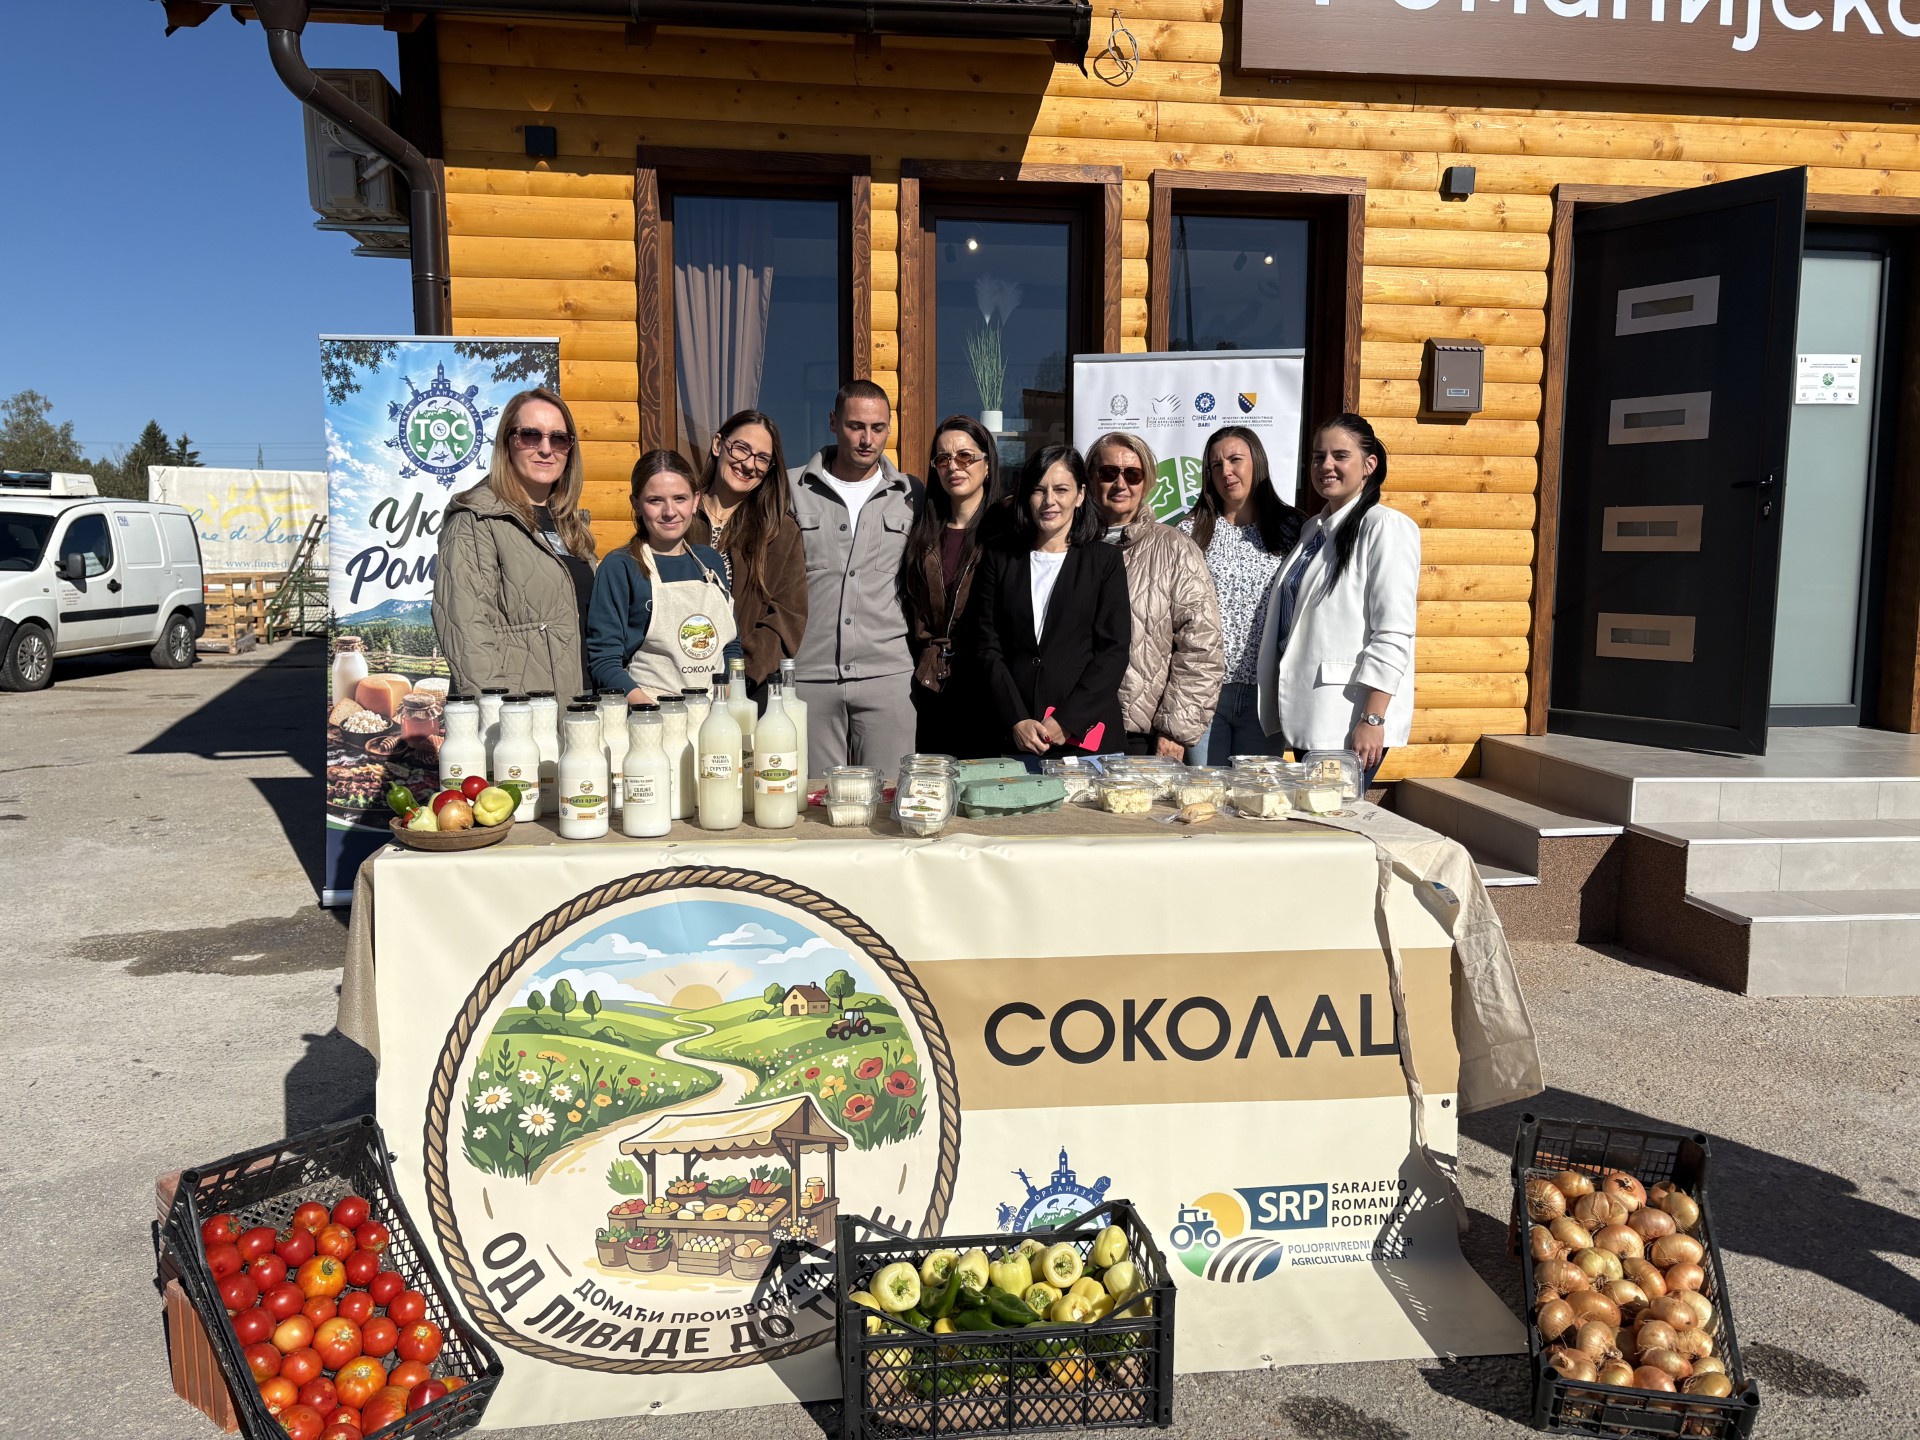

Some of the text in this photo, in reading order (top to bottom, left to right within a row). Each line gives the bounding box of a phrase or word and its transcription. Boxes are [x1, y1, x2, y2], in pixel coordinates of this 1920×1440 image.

[368, 491, 442, 549] Ук
[345, 545, 439, 605] Ром
[681, 664, 716, 674] СОКОЛА
[1331, 1179, 1408, 1195] SARAJEVO
[1258, 1189, 1325, 1224] SRP
[1331, 1195, 1411, 1211] ROMANIJA
[1331, 1212, 1406, 1228] PODRINJE
[1288, 1239, 1371, 1254] POLJOPRIVREDNI
[1291, 1251, 1408, 1266] AGRICULTURAL CLUSTER
[482, 1231, 795, 1360] ОД ЛИВАДЕ ДО
[572, 1278, 664, 1323] ДОМАЋИ
